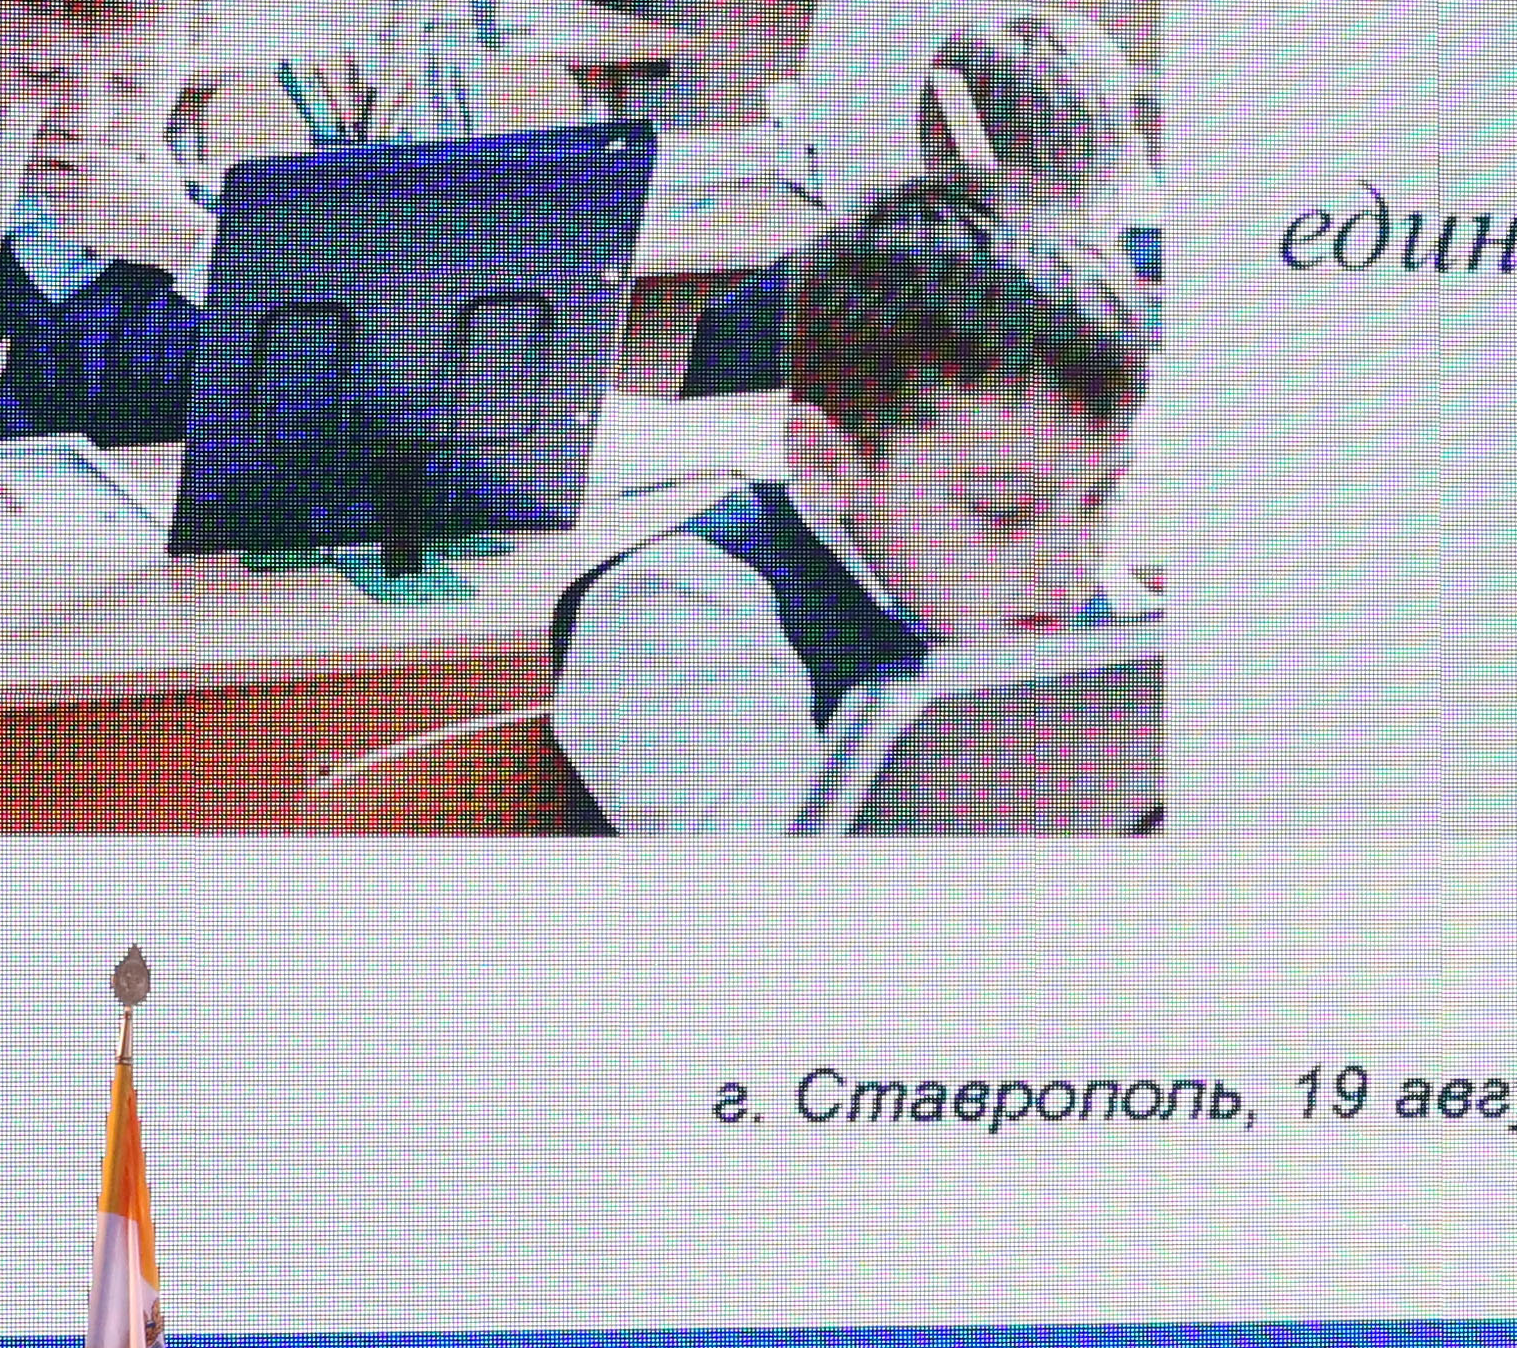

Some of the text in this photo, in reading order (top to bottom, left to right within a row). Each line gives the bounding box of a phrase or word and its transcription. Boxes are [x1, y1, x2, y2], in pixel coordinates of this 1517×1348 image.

[712, 1081, 763, 1125] г.
[795, 1066, 1255, 1135] Ставрополь,
[1299, 1064, 1371, 1120] 19
